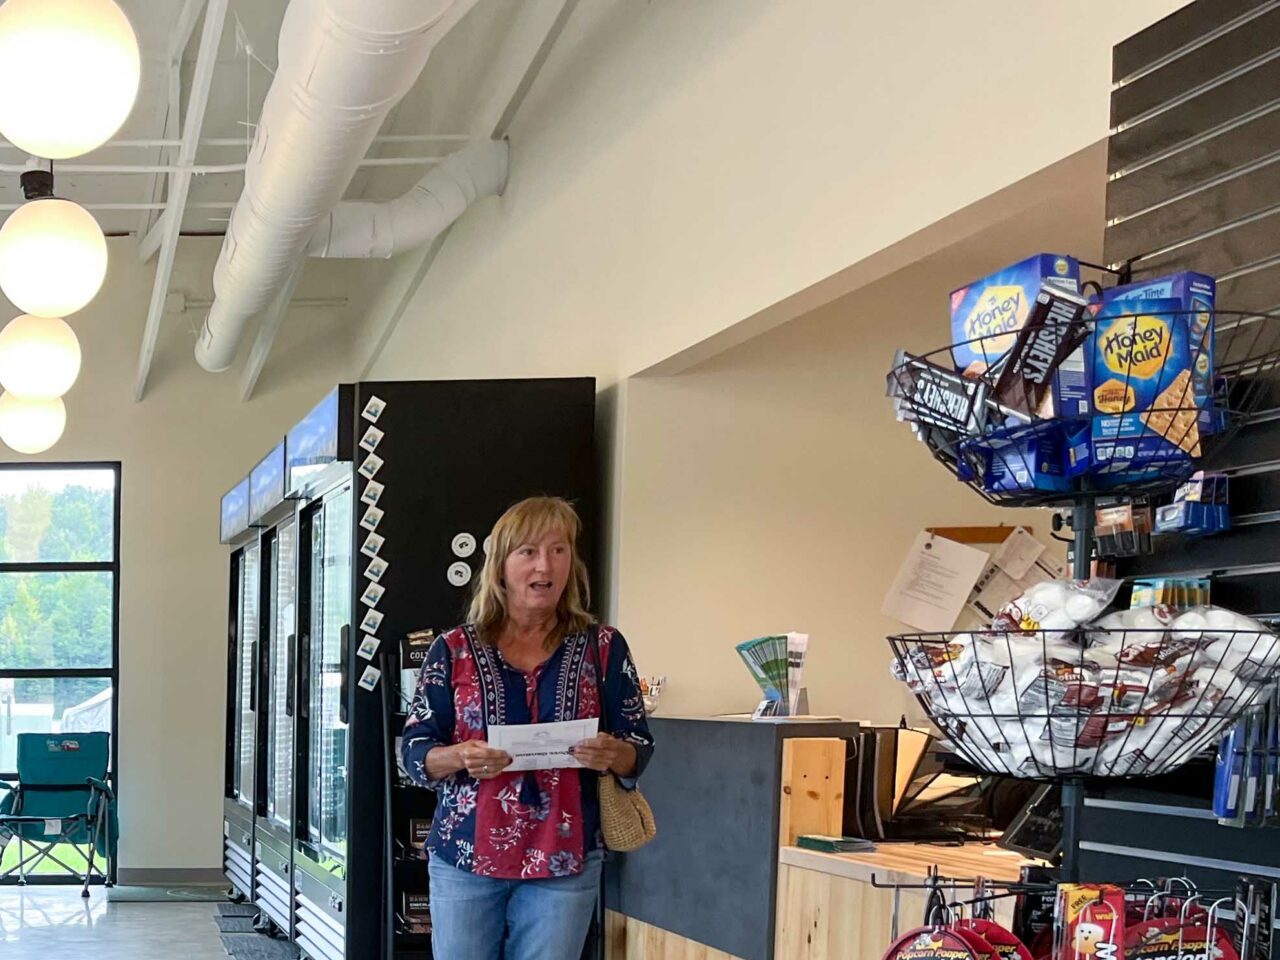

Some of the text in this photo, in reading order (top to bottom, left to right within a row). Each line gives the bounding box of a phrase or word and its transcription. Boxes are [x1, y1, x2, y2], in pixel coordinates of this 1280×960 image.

[1144, 286, 1165, 298] Time
[969, 292, 1020, 338] Honey
[1022, 301, 1078, 383] HERSHEY'S
[1105, 325, 1163, 354] Honey
[1116, 343, 1162, 368] Maid
[1070, 894, 1088, 910] FREE
[896, 949, 969, 960] Popcorn Popper
